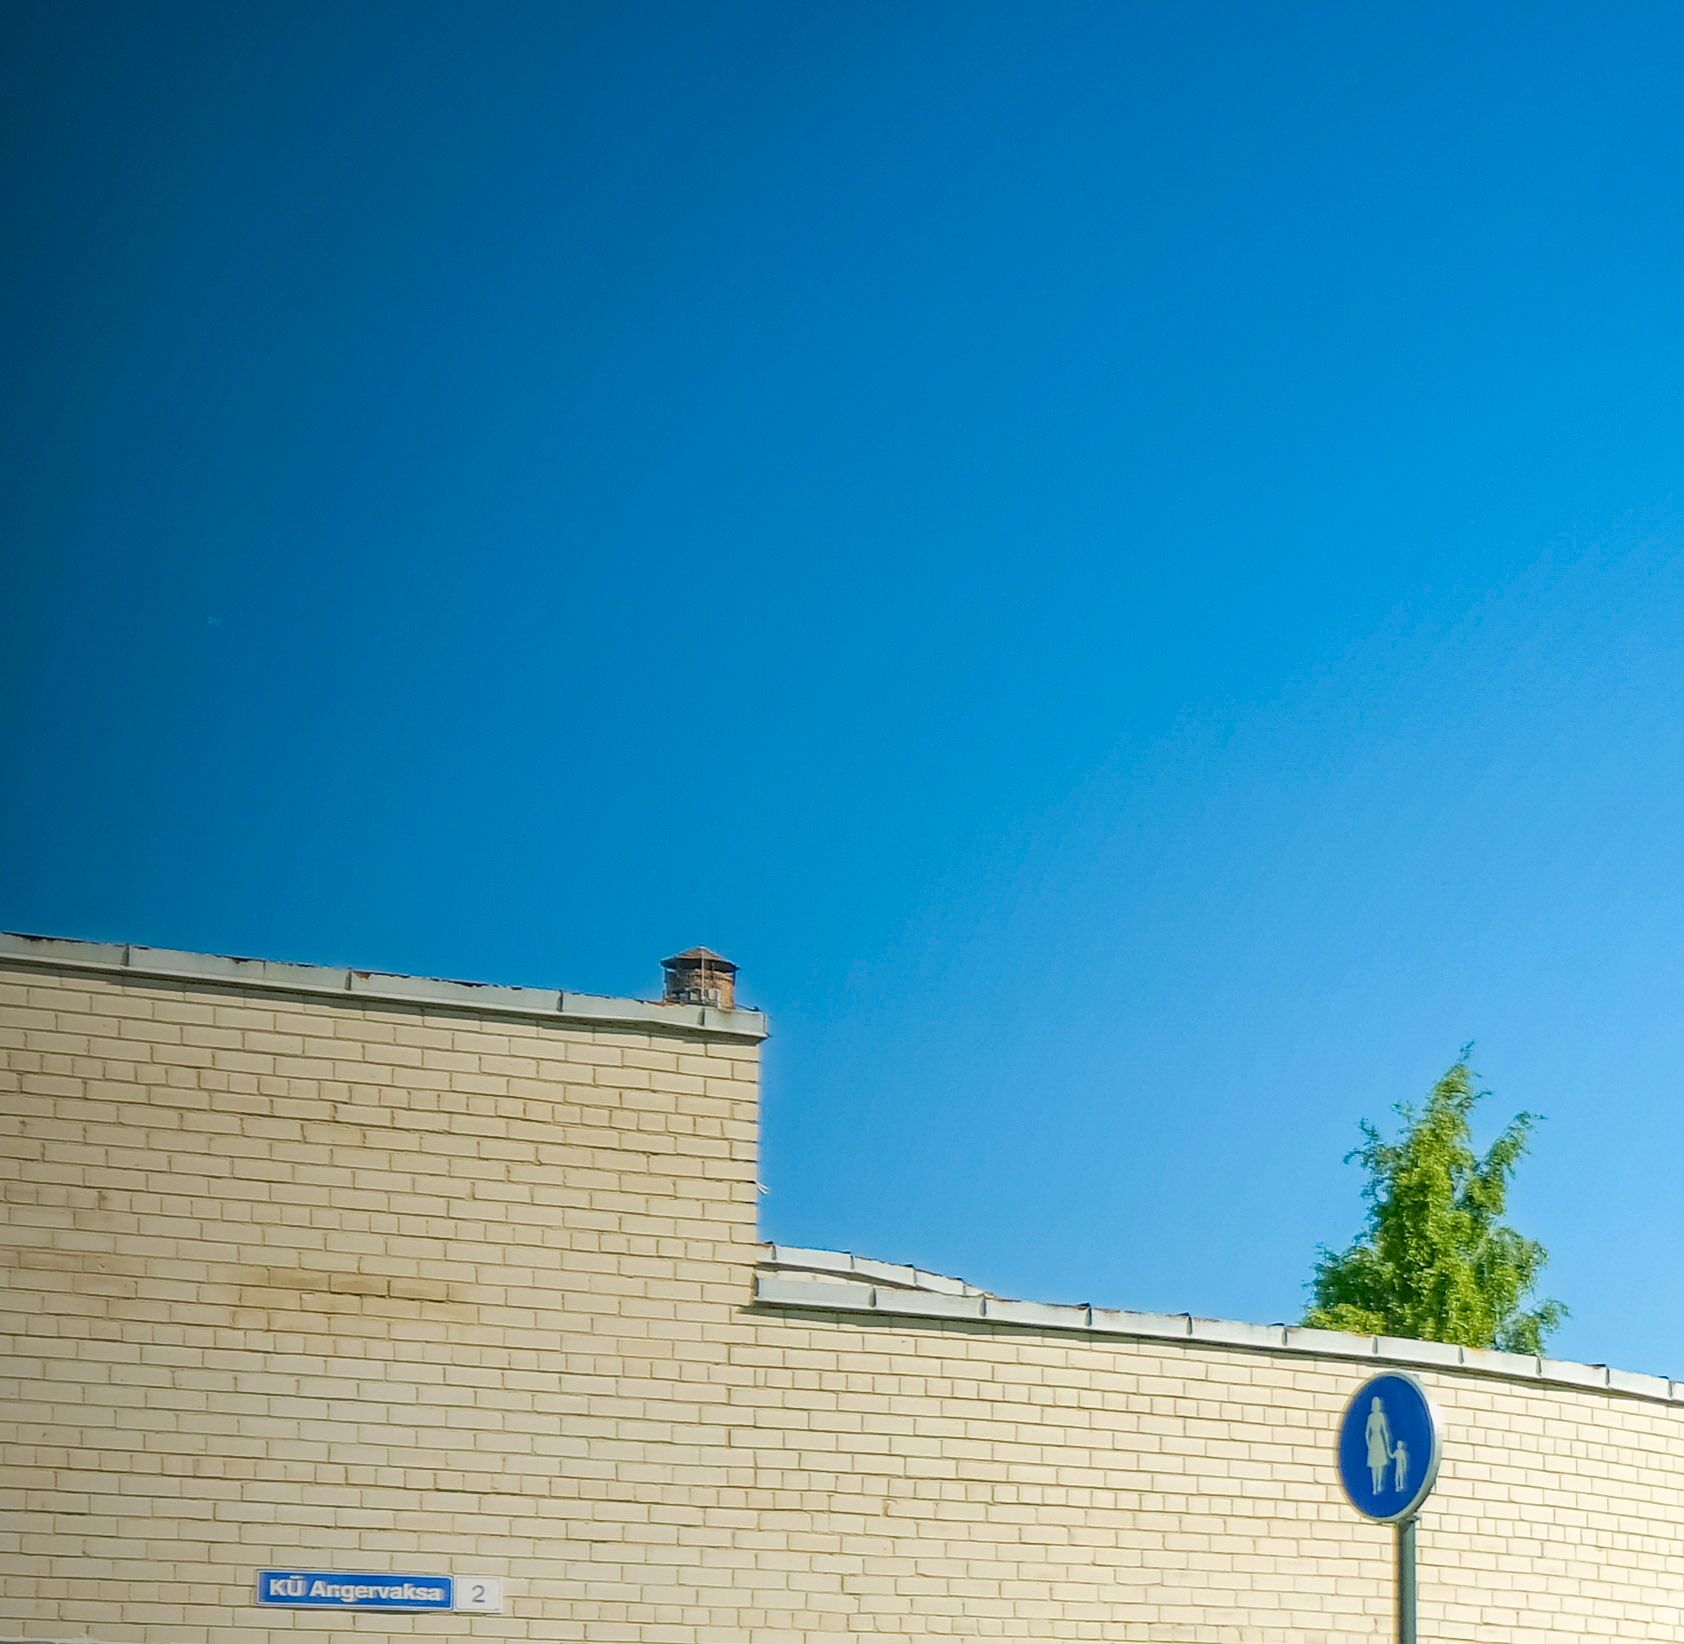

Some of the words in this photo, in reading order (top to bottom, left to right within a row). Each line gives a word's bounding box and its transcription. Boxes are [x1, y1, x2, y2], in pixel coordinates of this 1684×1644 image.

[269, 1575, 304, 1597] KÜ
[309, 1579, 443, 1602] Angervaksa
[471, 1584, 486, 1603] 2
